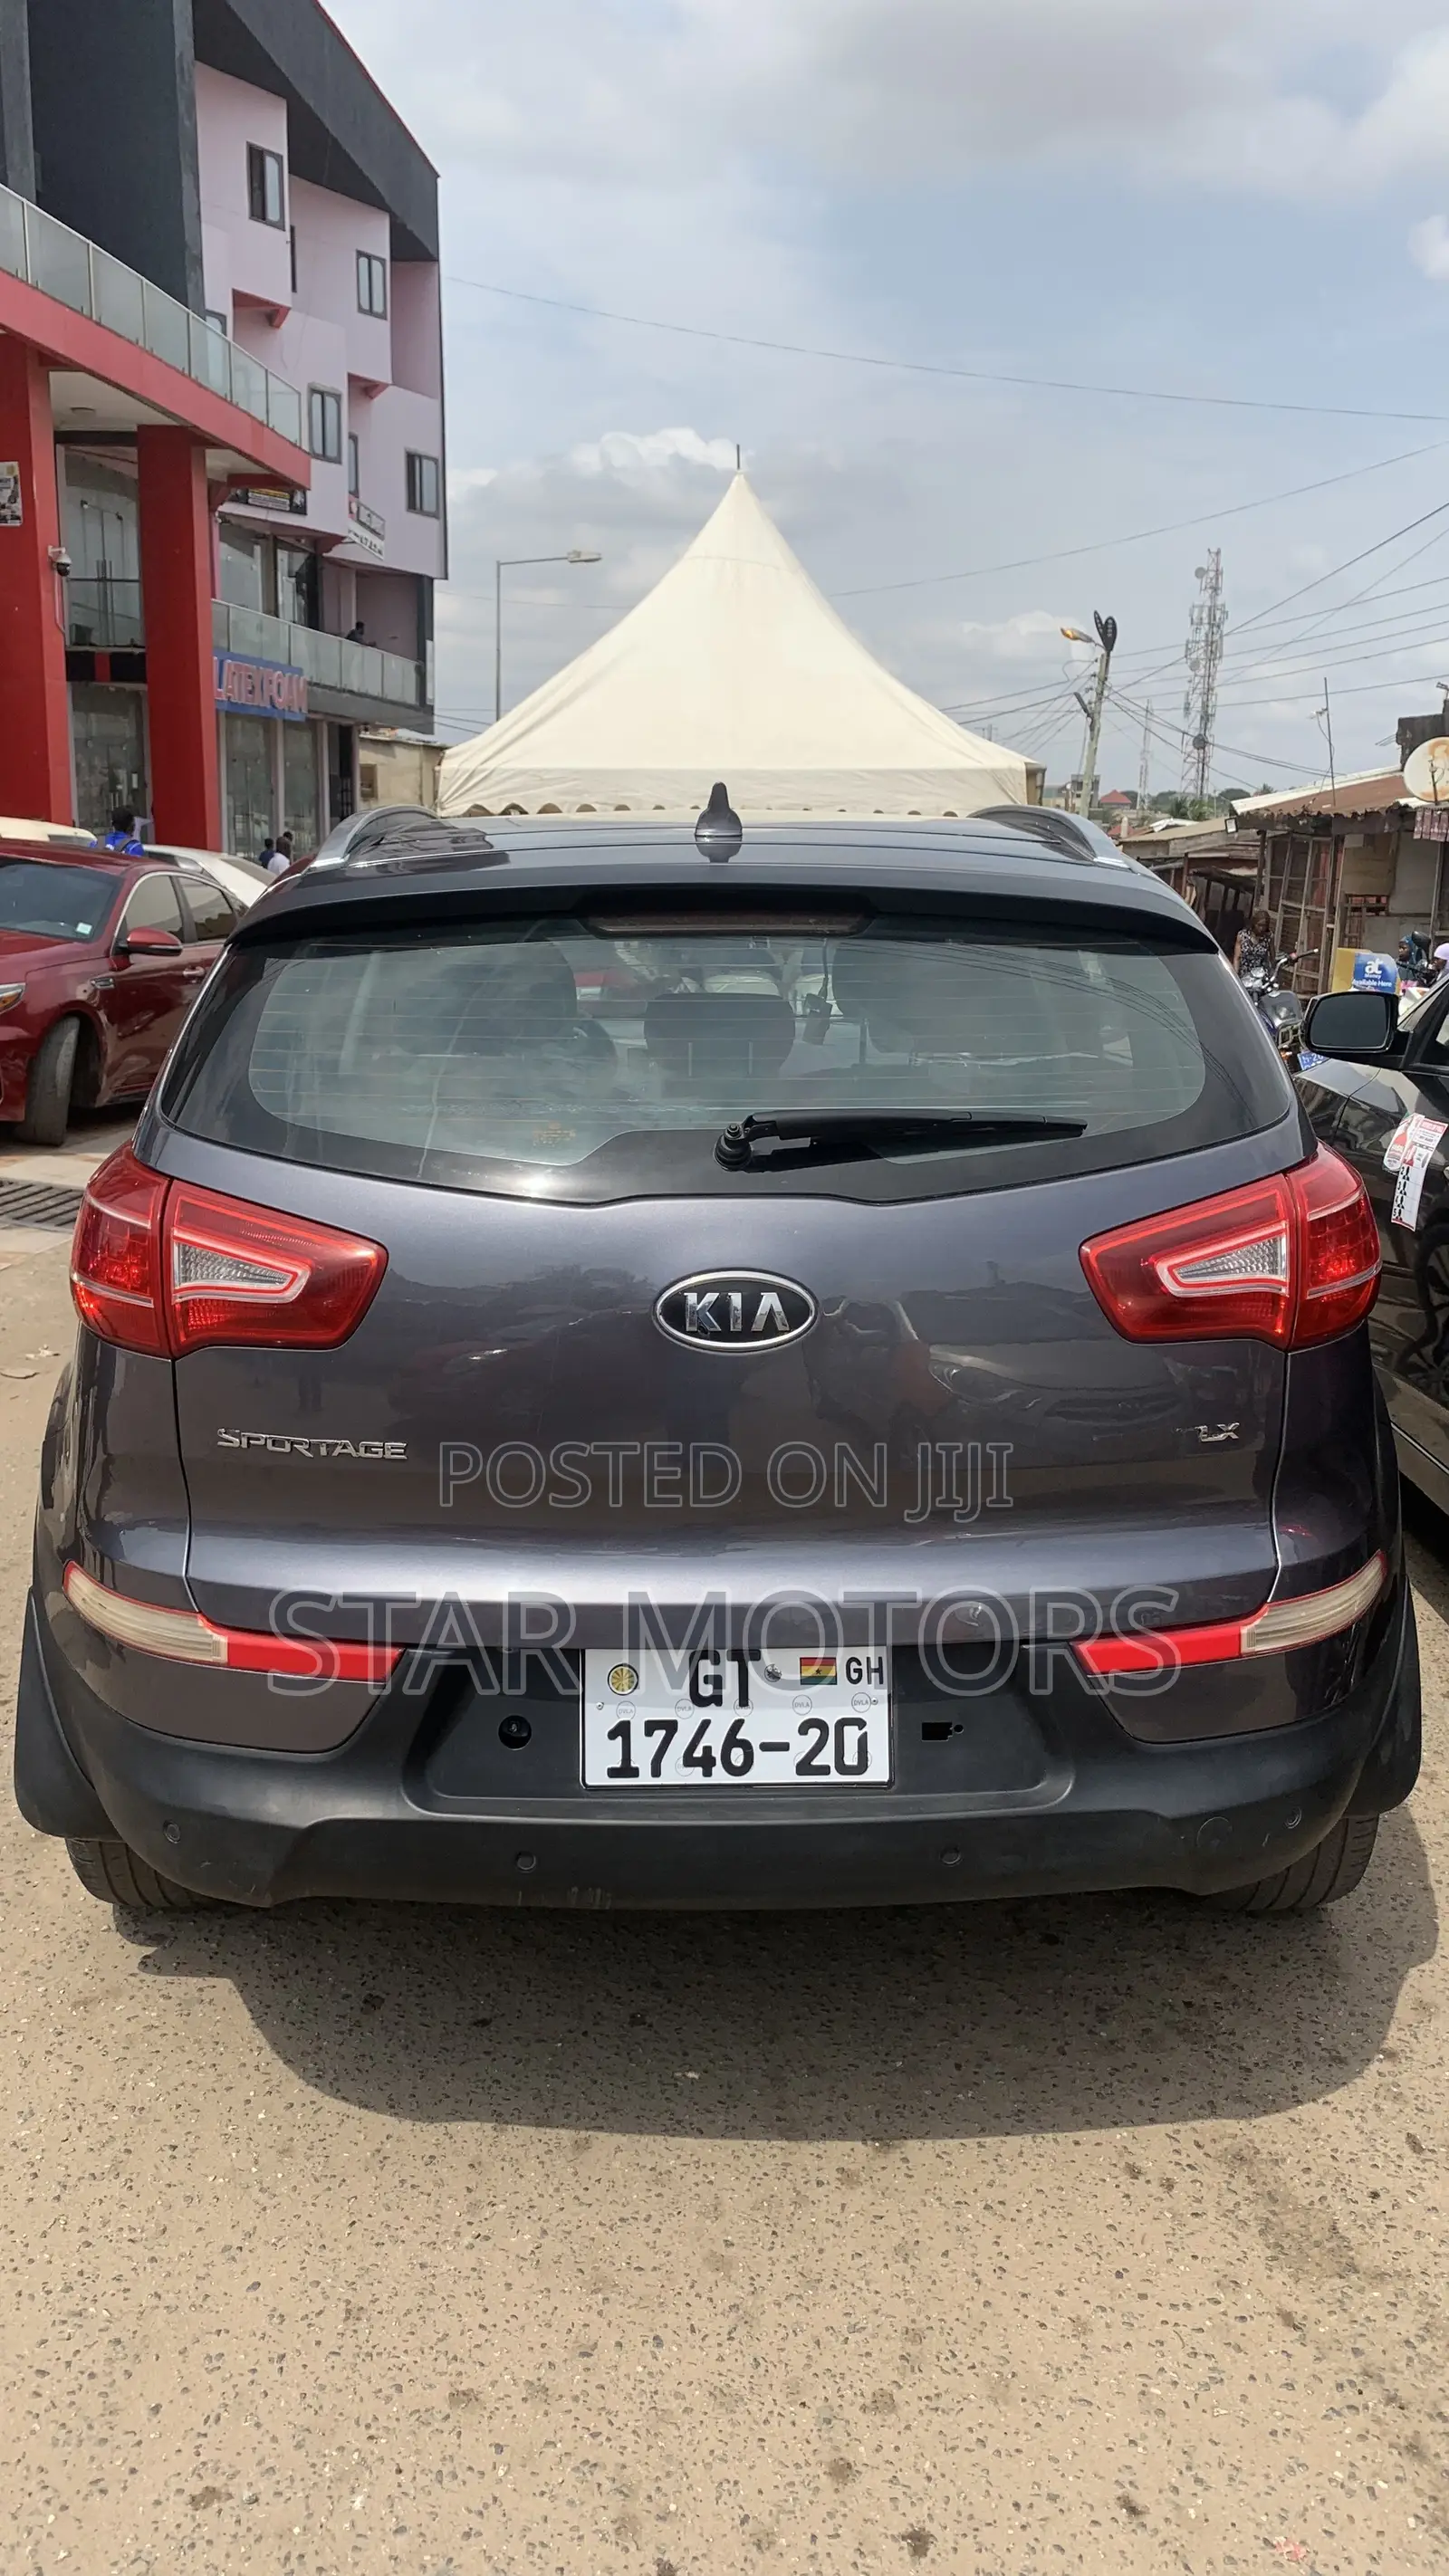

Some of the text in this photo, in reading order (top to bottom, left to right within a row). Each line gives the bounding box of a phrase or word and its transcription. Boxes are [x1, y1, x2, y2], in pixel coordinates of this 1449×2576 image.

[213, 656, 308, 713] LATEXFOAM
[684, 1292, 790, 1331] KIA
[217, 1428, 408, 1460] SPORTAGE
[1197, 1422, 1240, 1442] LX
[688, 1649, 885, 1708] GT GH
[607, 1718, 868, 1777] 1746-20
